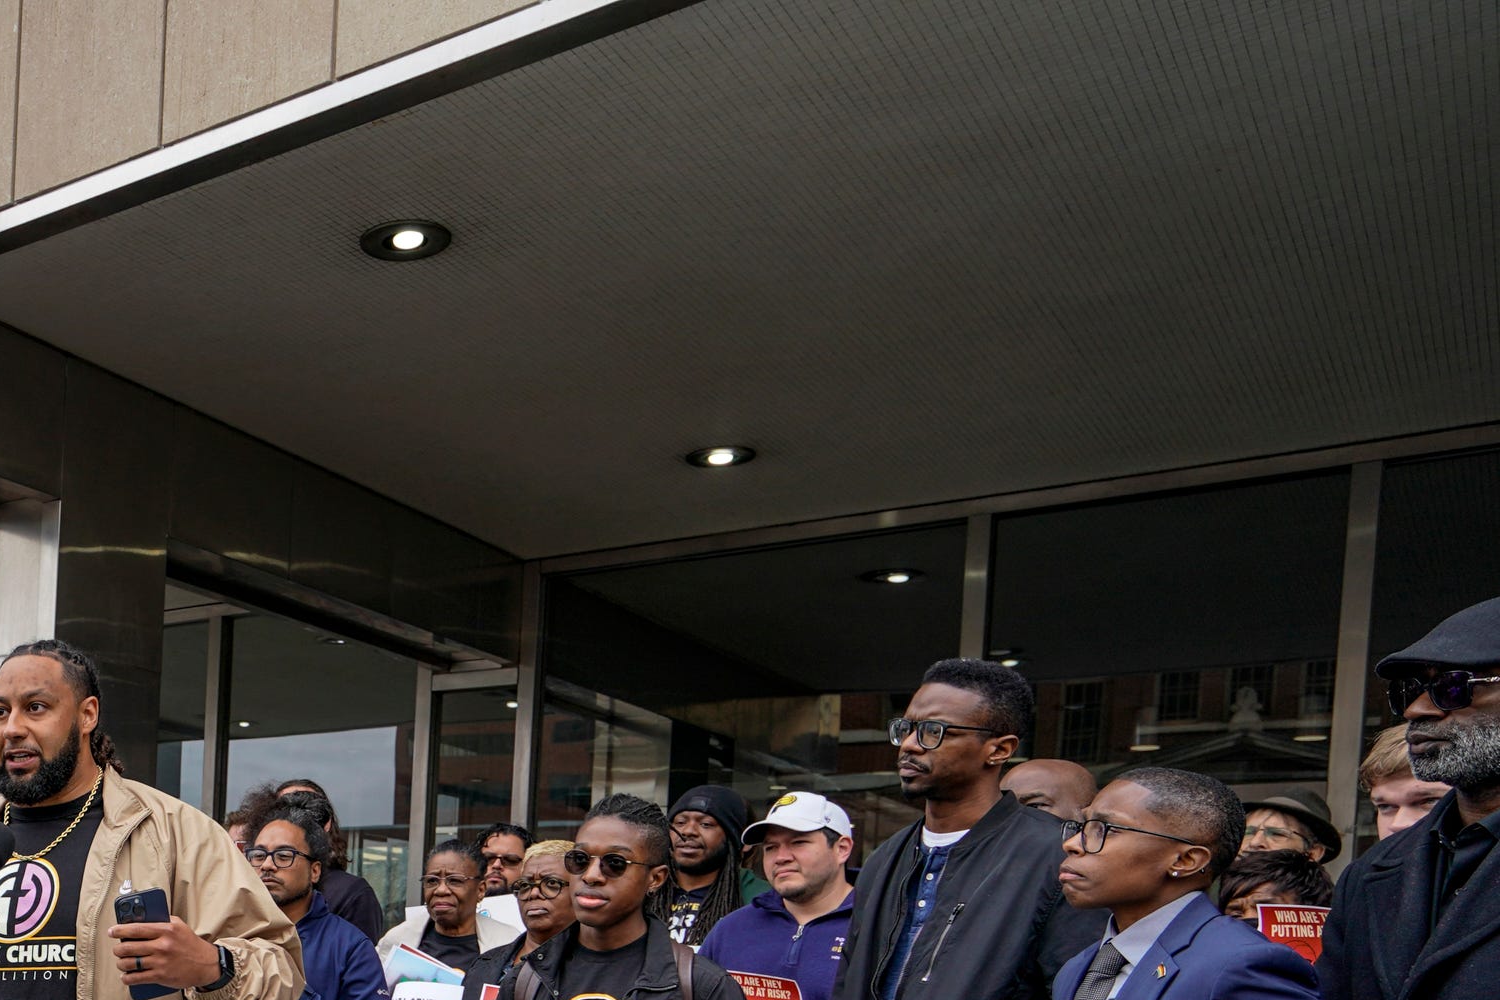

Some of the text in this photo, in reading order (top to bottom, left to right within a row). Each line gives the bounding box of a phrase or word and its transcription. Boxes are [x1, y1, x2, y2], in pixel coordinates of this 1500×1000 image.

[1274, 910, 1298, 923] WHO
[1299, 911, 1320, 924] ARE
[1271, 924, 1323, 938] PUTTING A
[6, 943, 76, 963] CHURC
[744, 976, 760, 987] ARE
[761, 978, 782, 989] THEY
[756, 987, 766, 998] AT
[768, 988, 792, 1000] RISK?
